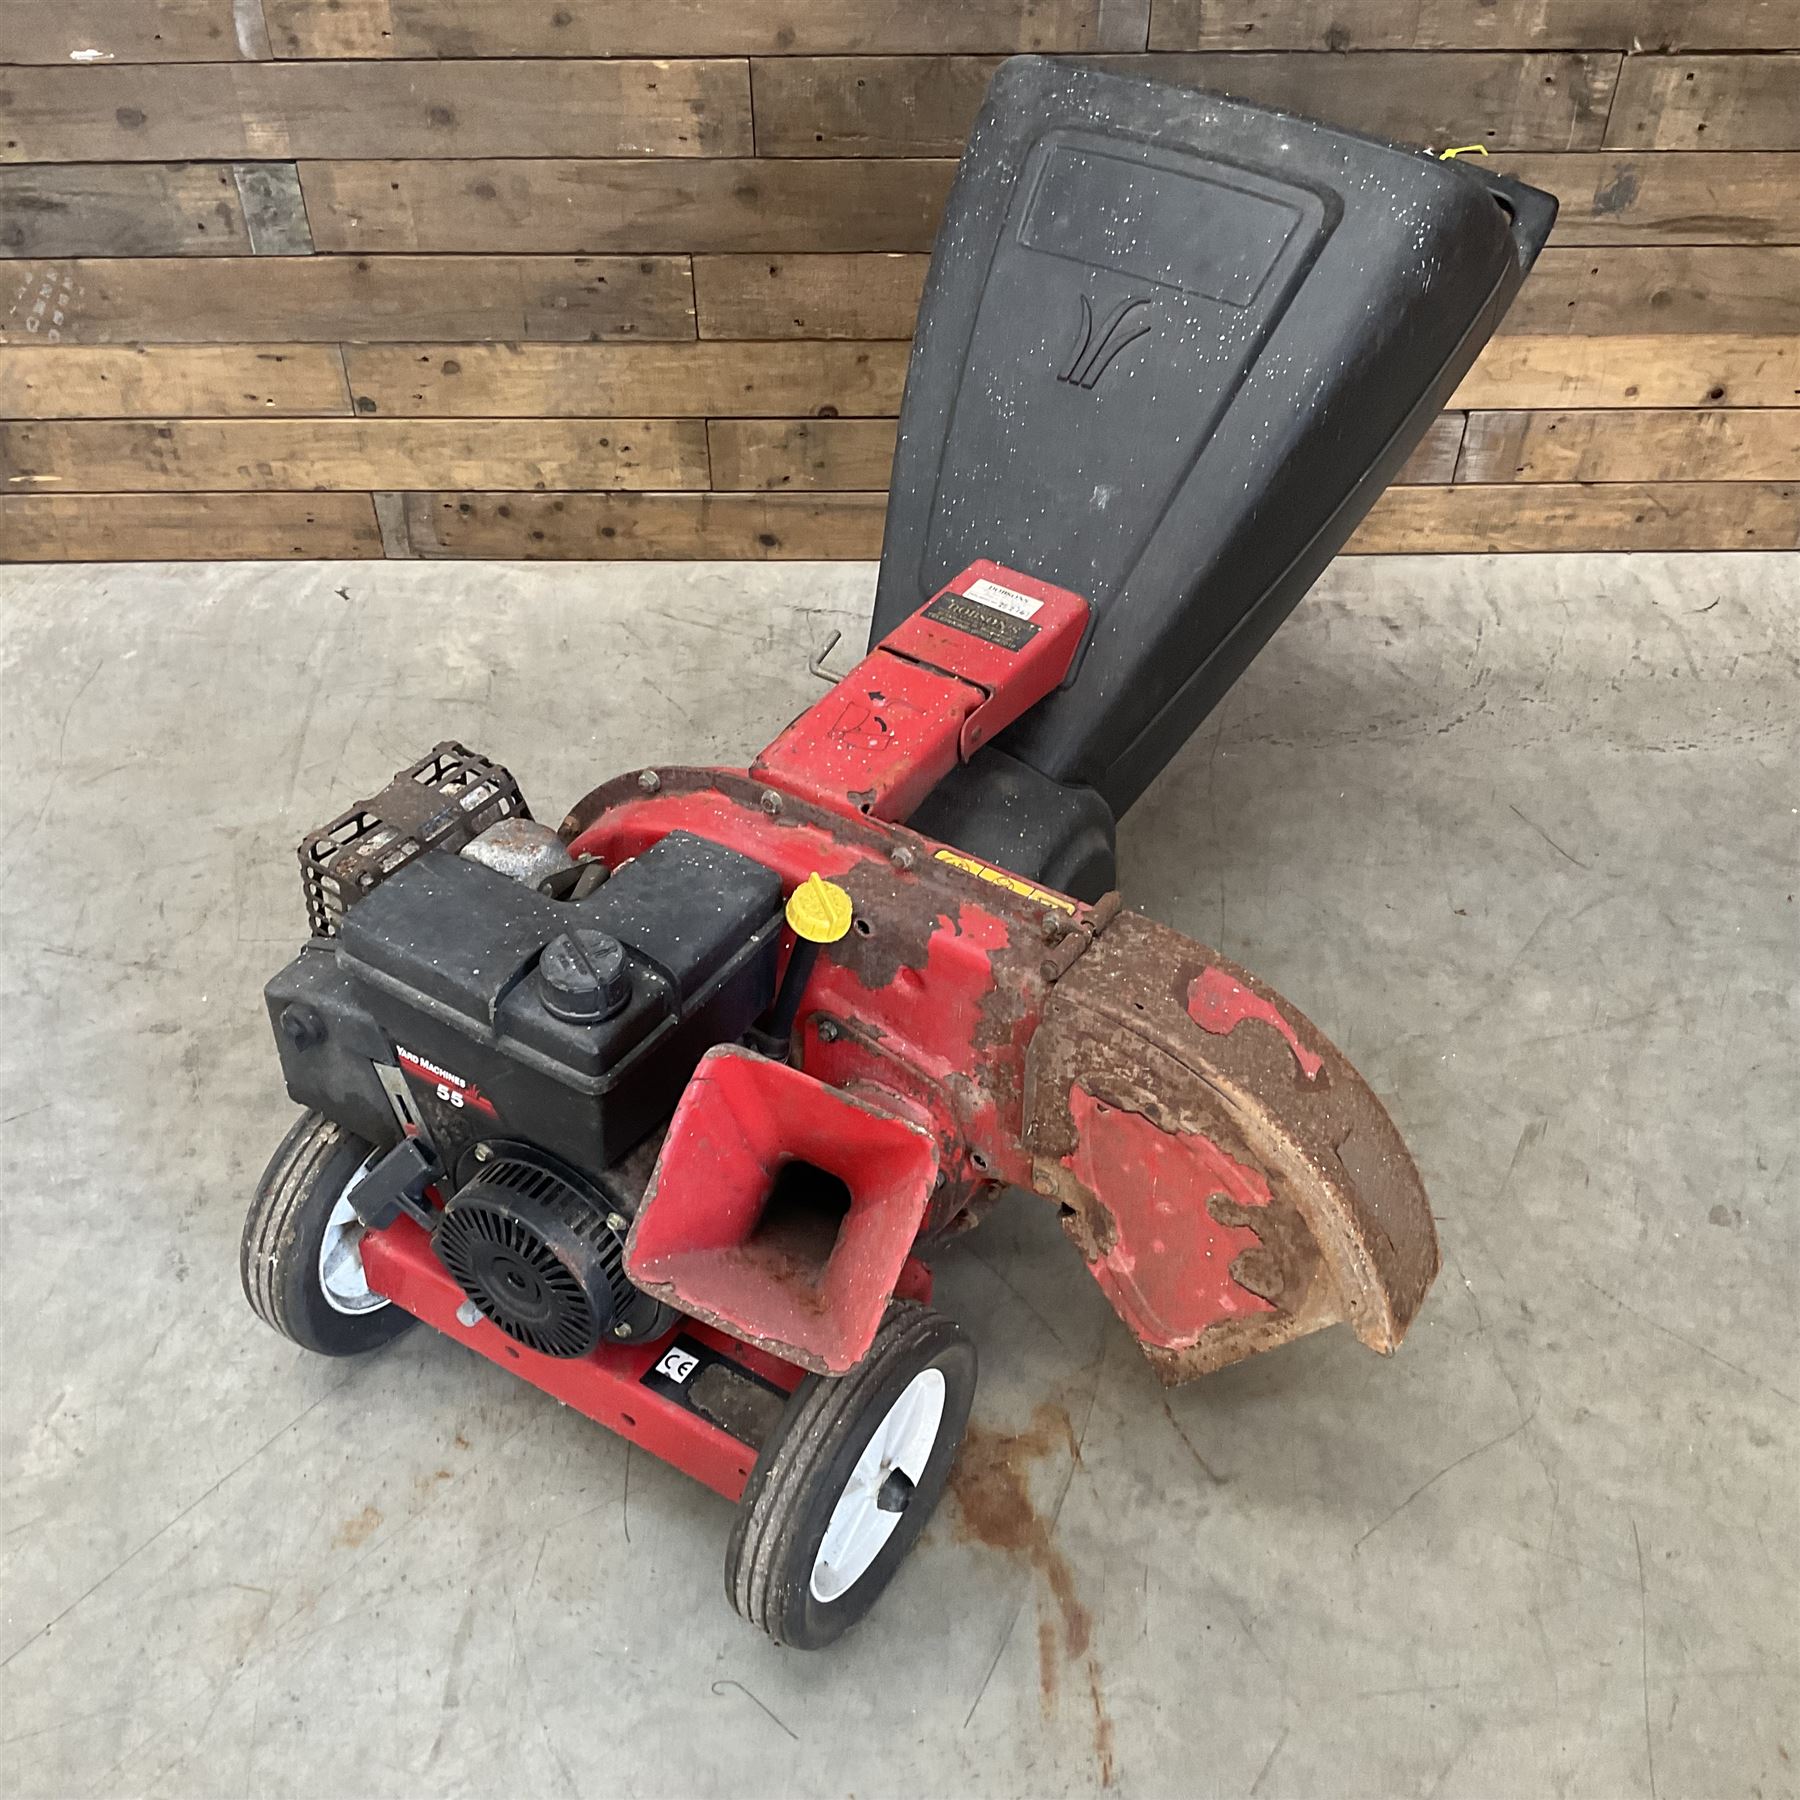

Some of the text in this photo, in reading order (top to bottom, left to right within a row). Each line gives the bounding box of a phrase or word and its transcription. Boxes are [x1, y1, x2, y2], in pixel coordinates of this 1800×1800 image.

[396, 1045, 466, 1089] YARD MACHINES
[436, 1083, 464, 1108] 55
[664, 1354, 693, 1377] CE
